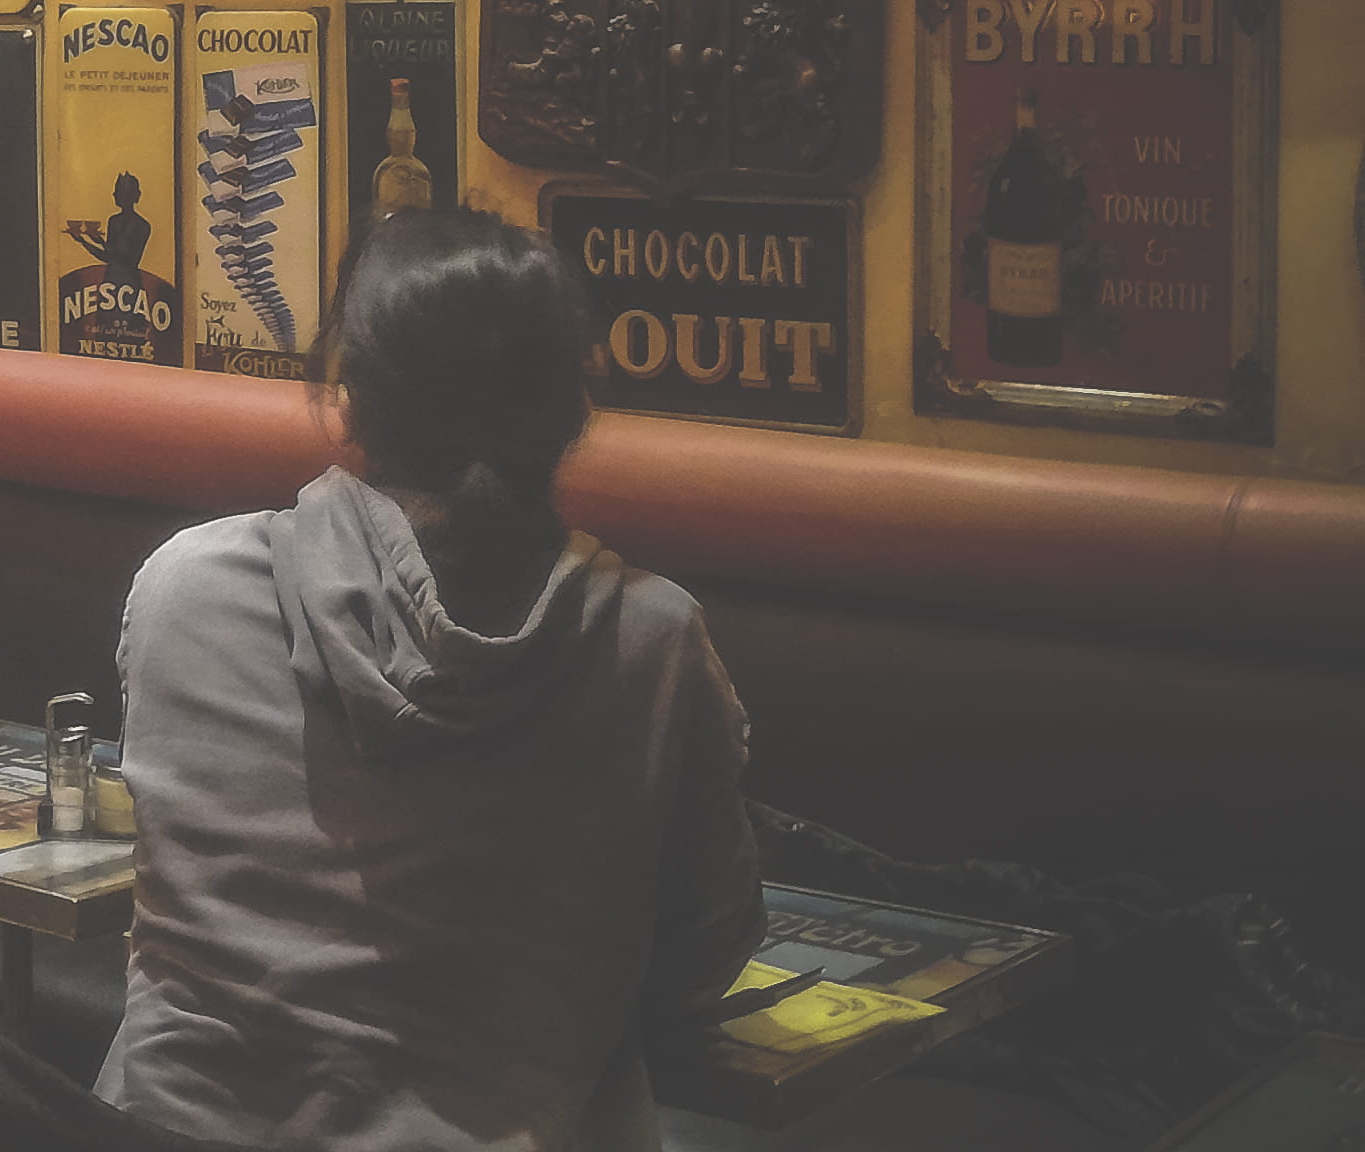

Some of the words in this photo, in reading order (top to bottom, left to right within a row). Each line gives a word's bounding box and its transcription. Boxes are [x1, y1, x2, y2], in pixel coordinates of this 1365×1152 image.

[63, 18, 170, 64] NESCAO
[197, 28, 313, 55] CHOCOLAT
[80, 70, 109, 79] PETIT
[1132, 134, 1183, 166] VIN
[1101, 191, 1213, 231] TONIQUE
[583, 225, 813, 288] CHOCOLAT
[64, 281, 171, 332] NESCAO
[200, 292, 237, 314] Soyez
[1101, 279, 1213, 313] APERITIF
[78, 339, 155, 361] NESTLÉ
[223, 351, 305, 378] KOHLER
[583, 310, 836, 392] OUIT
